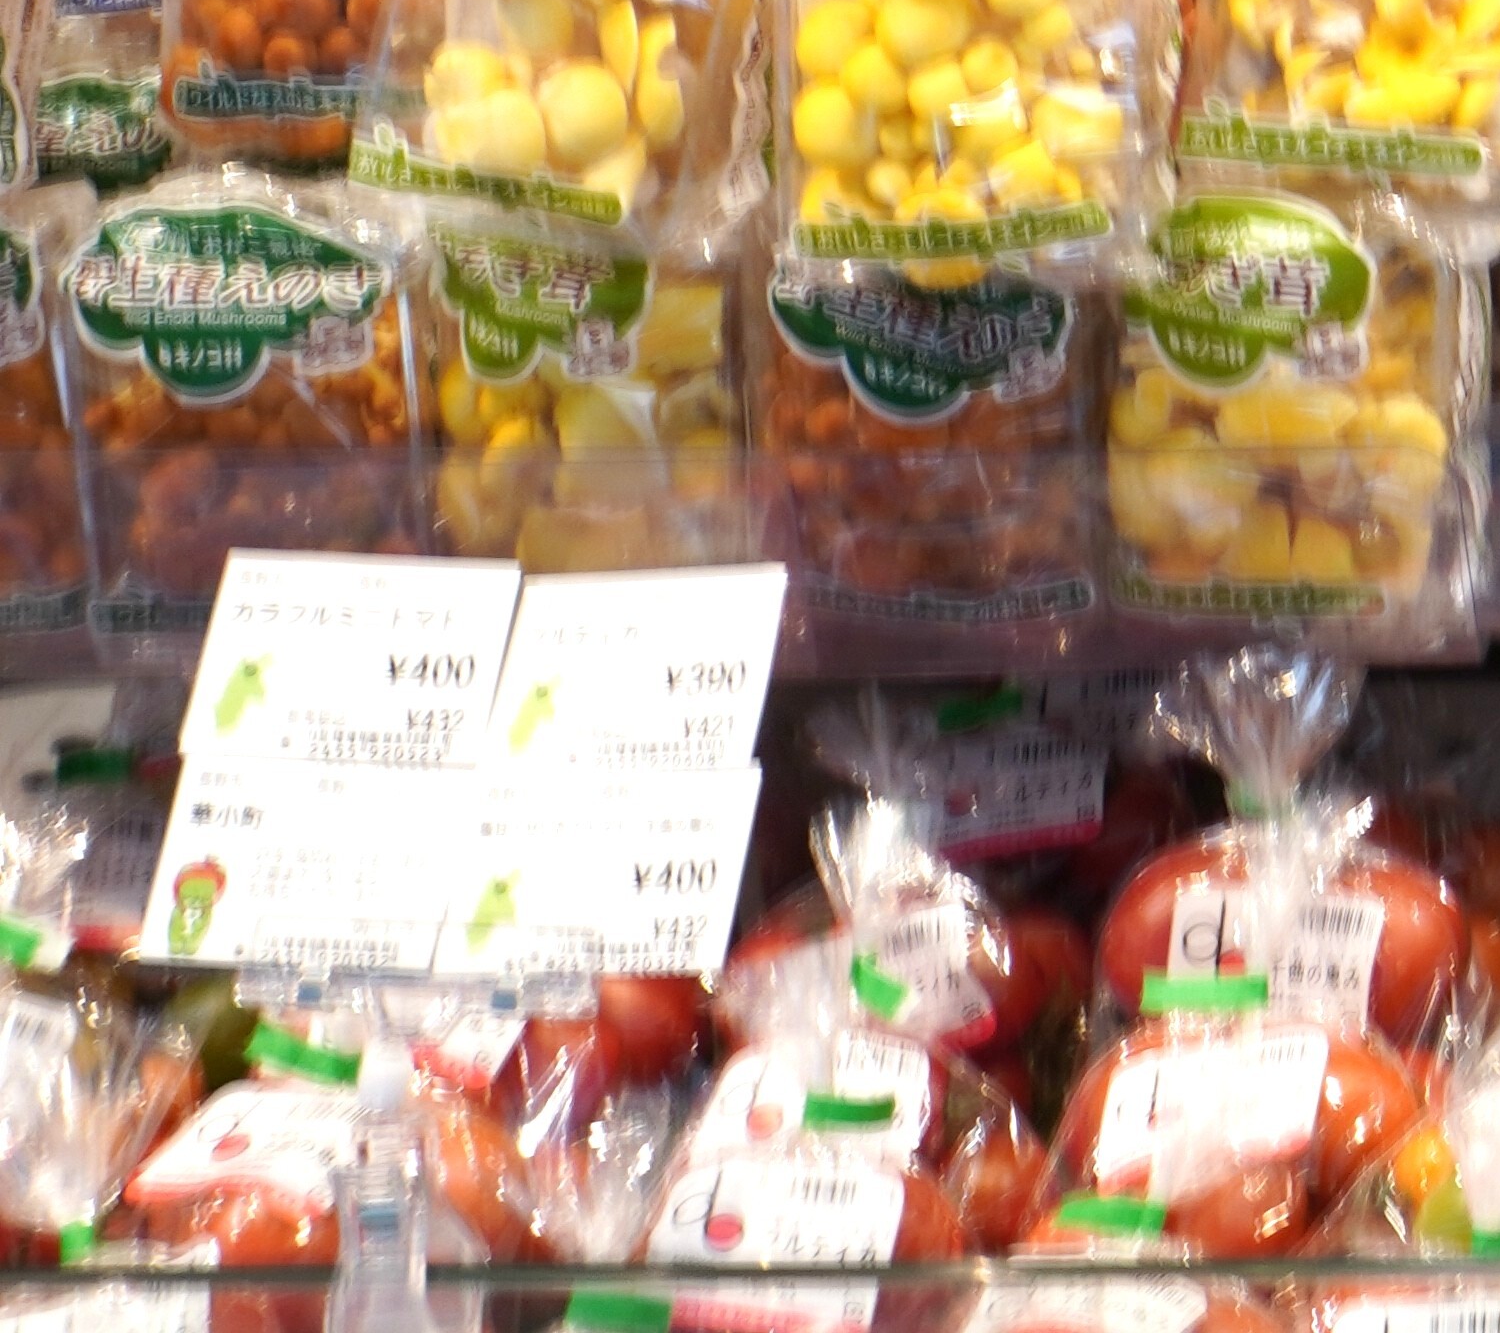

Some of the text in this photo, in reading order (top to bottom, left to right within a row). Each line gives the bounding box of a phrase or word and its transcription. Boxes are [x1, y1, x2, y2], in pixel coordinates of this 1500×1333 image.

[387, 651, 476, 690] ¥400
[406, 709, 465, 733] ¥432
[632, 859, 718, 894] ¥400
